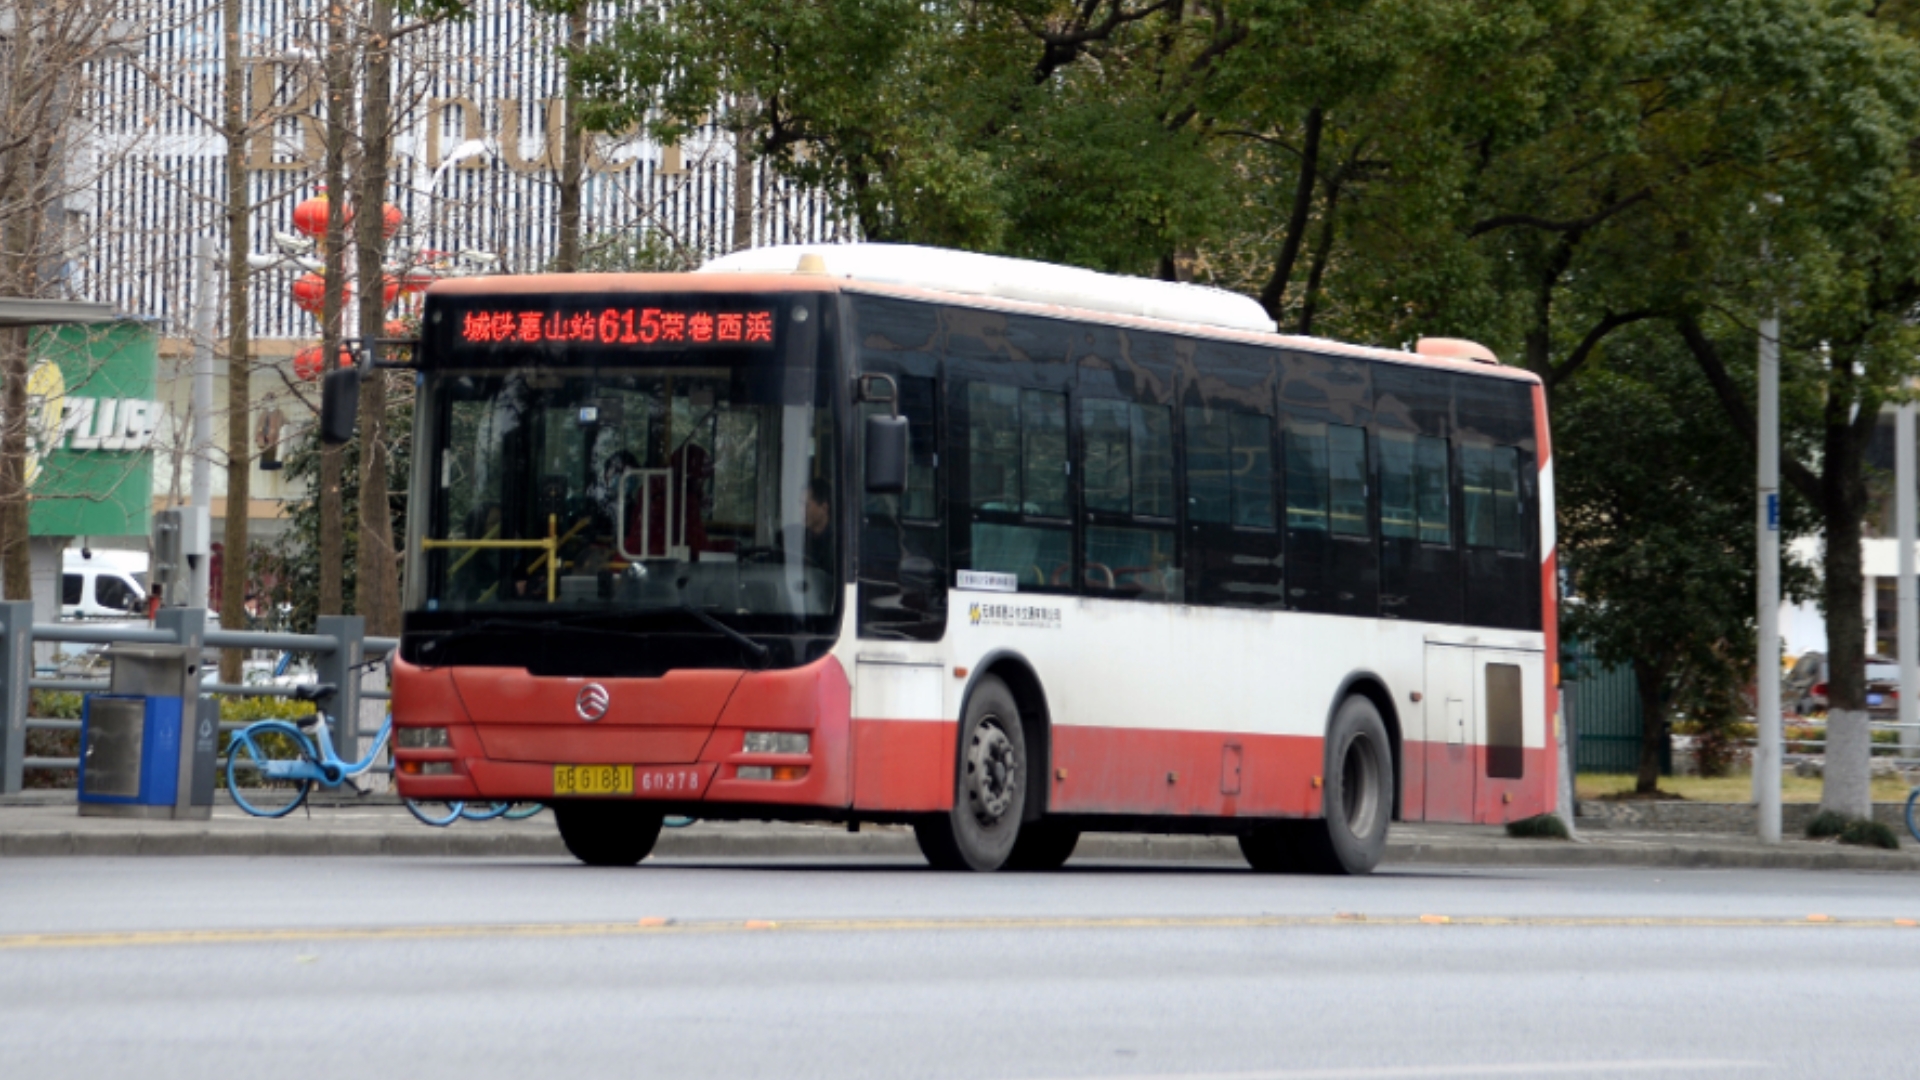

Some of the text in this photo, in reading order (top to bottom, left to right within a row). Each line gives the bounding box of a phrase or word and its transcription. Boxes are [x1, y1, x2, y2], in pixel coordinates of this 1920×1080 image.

[463, 311, 596, 342] 城铁惠山站
[600, 308, 661, 343] 615
